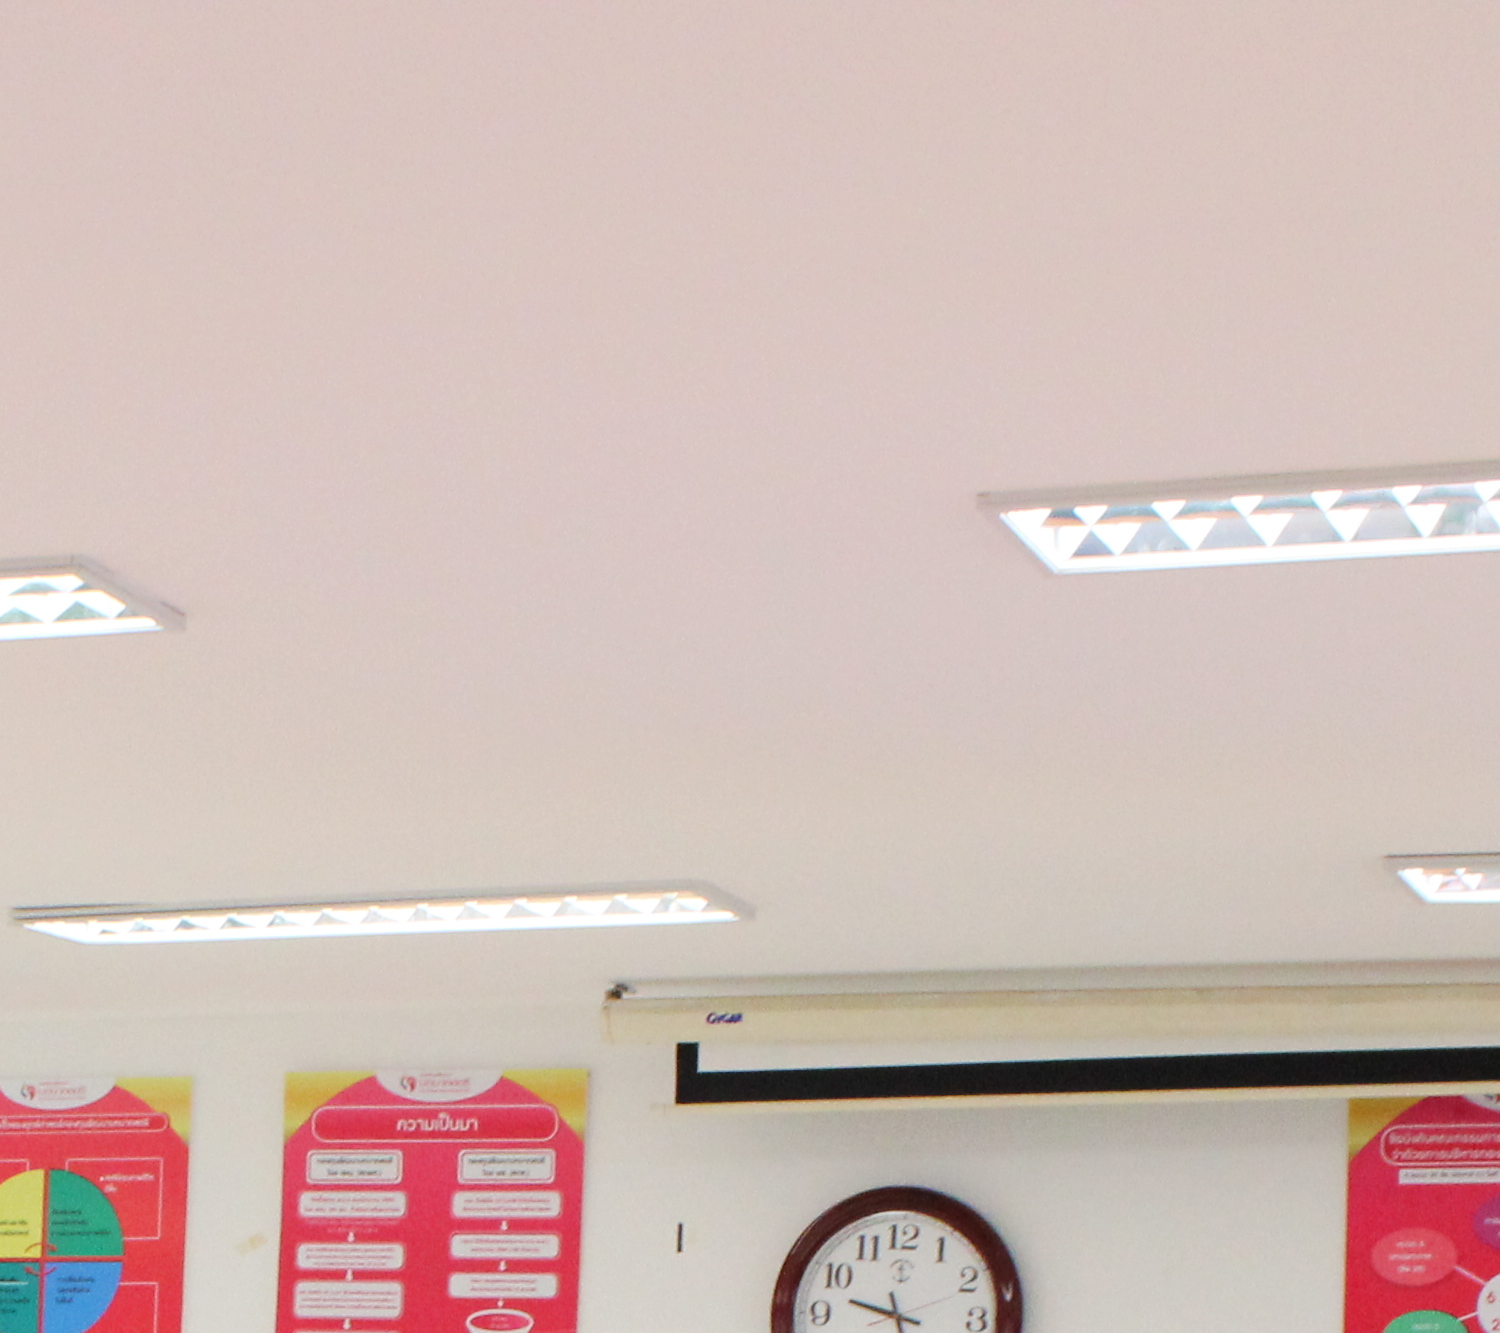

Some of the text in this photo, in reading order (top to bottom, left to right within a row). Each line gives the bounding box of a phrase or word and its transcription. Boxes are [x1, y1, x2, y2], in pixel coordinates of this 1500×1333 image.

[396, 1112, 478, 1131] ความเป็นมา
[856, 1236, 880, 1262] 11
[889, 1225, 921, 1250] 12
[934, 1237, 947, 1262] 1
[823, 1263, 853, 1289] 10
[958, 1268, 979, 1293] 2
[1486, 1291, 1497, 1304] 6
[811, 1302, 831, 1327] 9
[966, 1307, 987, 1333] 3
